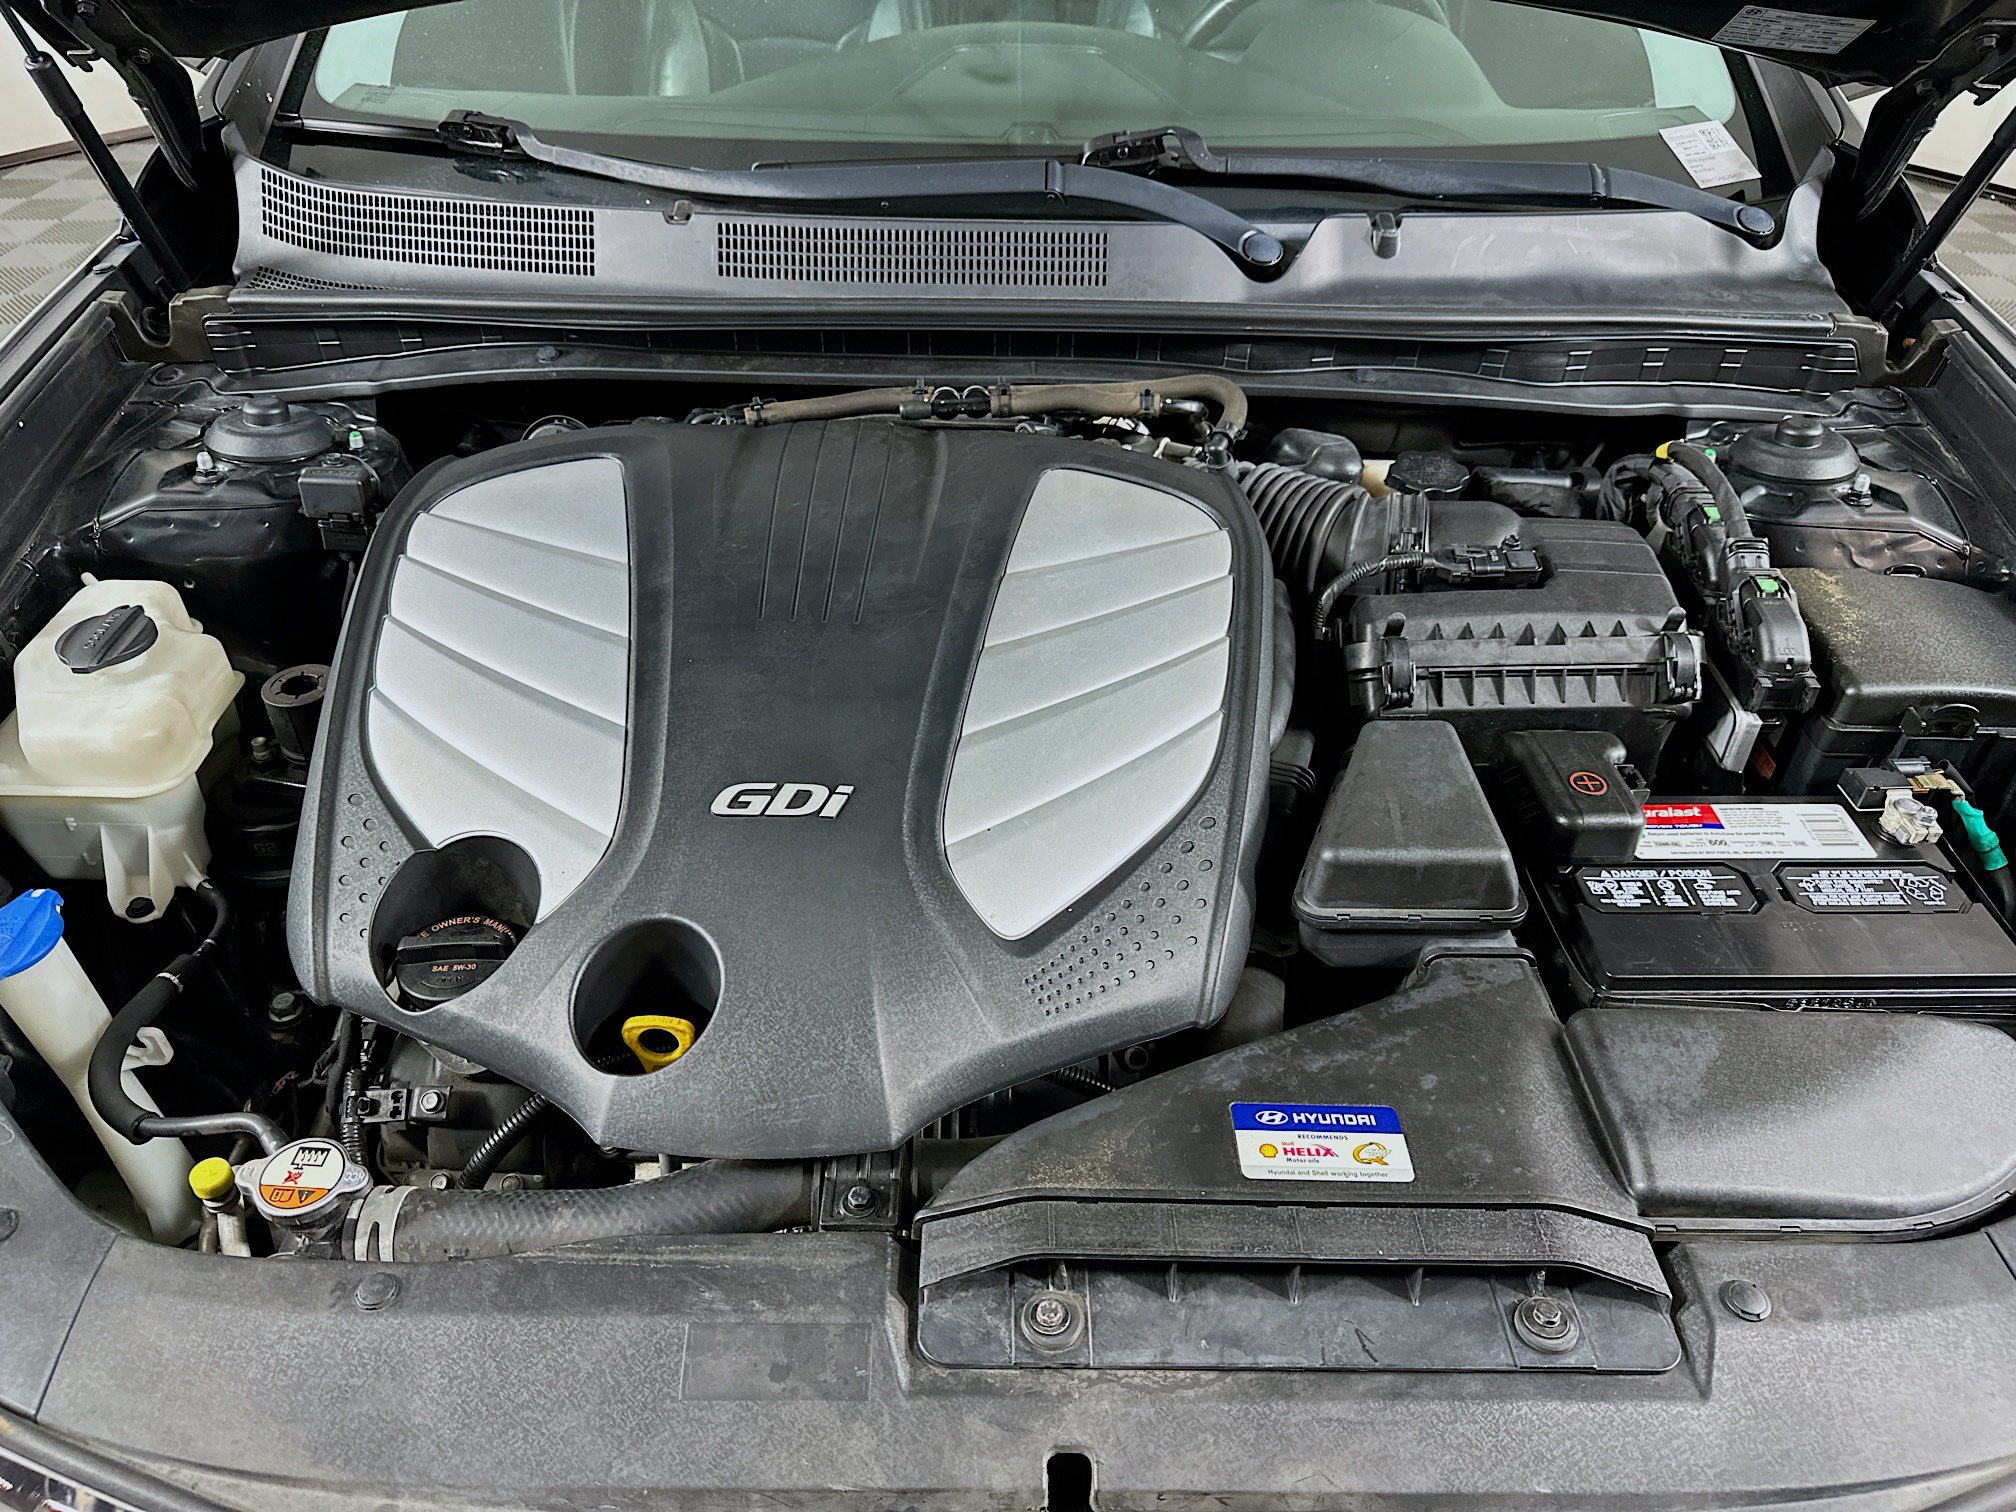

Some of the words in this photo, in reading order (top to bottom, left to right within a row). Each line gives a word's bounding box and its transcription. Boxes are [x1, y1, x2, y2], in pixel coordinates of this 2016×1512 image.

[710, 782, 855, 819] GDi
[1643, 806, 1703, 818] uralast
[1610, 870, 1658, 878] DANGER
[1669, 869, 1713, 877] POISON
[431, 916, 481, 932] OWNER'S
[452, 963, 477, 971] 5W-30
[1292, 1112, 1377, 1126] HYUNDAI
[1283, 1145, 1338, 1157] HELIX
[1330, 1170, 1358, 1178] working
[1360, 1171, 1388, 1179] together
